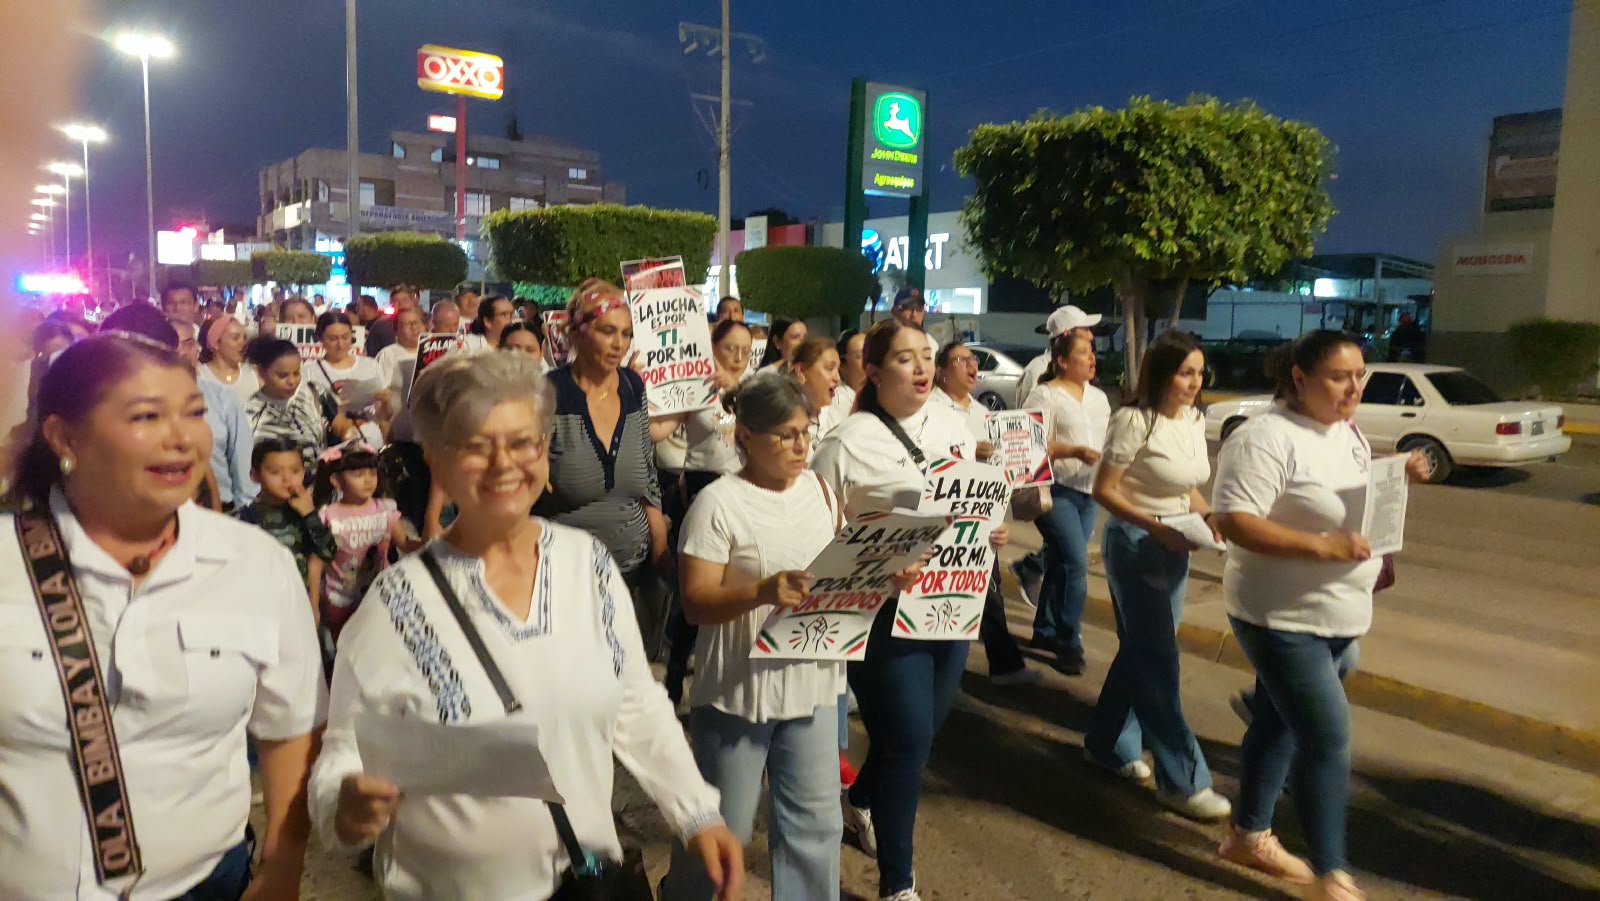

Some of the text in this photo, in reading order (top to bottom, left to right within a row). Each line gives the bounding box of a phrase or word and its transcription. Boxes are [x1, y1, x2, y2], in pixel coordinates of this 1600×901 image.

[424, 55, 500, 89] OXXO
[639, 298, 698, 323] LA LUCHA
[651, 313, 686, 329] ES POR
[647, 349, 676, 367] POR
[642, 358, 712, 385] POR TODOS
[934, 477, 1006, 505] LA LUCHA
[971, 502, 994, 517] POR
[846, 524, 945, 545] LA LUCHA
[926, 545, 968, 567] POR
[810, 577, 864, 592] POR
[906, 569, 989, 595] POR TODOS
[824, 590, 888, 610] TODOS
